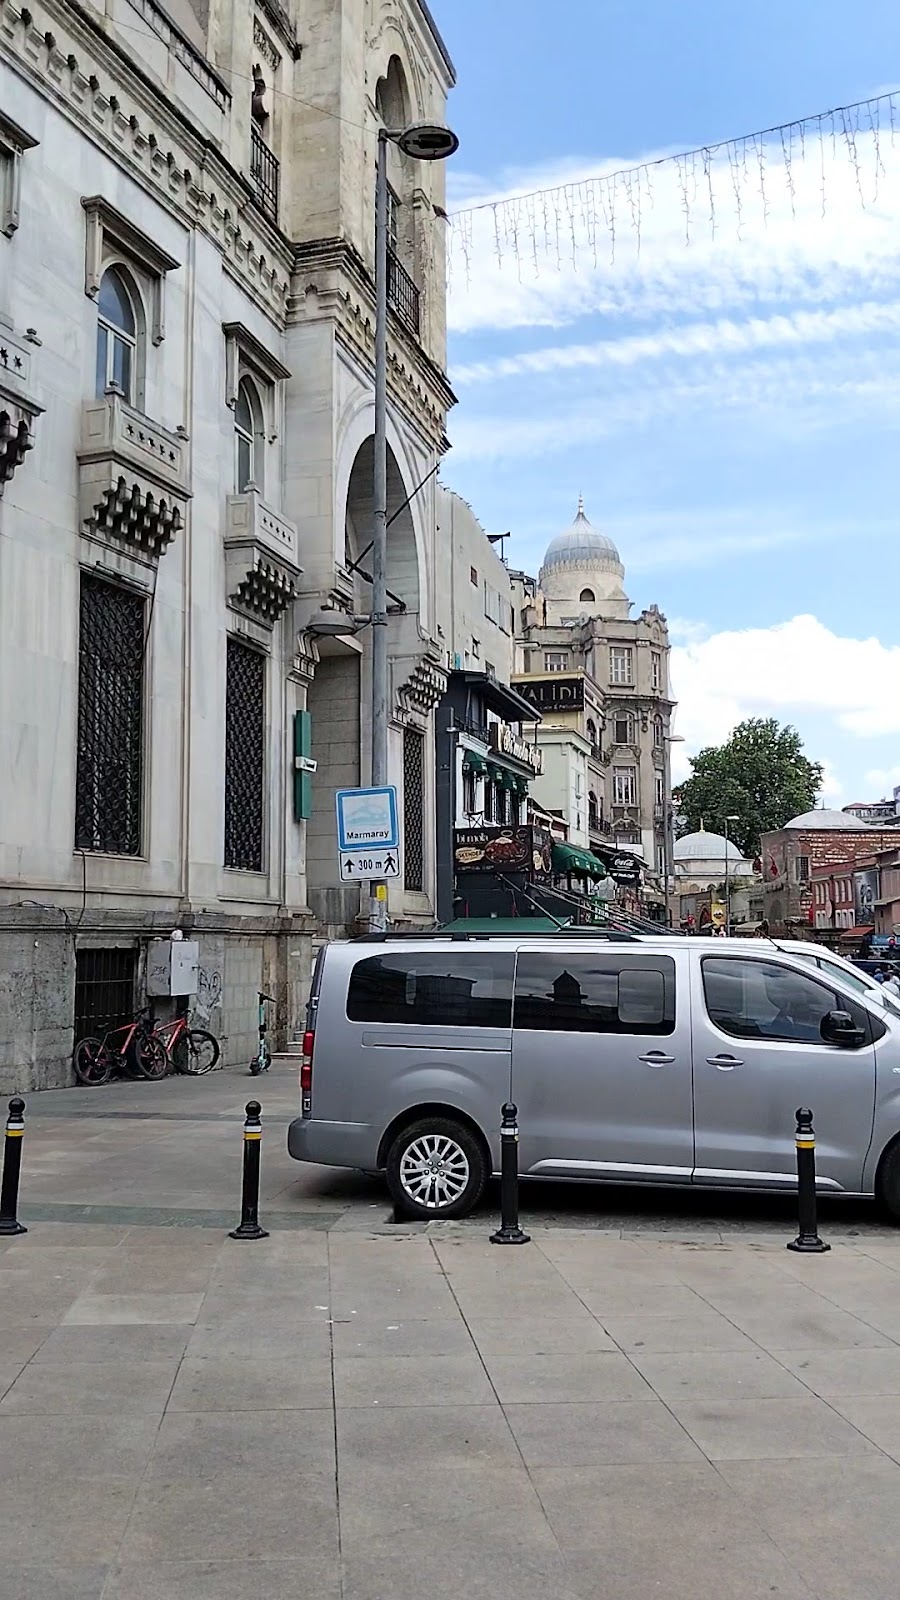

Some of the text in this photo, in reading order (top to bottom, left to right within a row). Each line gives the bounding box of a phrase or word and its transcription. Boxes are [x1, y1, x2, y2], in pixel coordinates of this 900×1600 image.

[346, 831, 389, 839] Marmaray
[358, 859, 382, 870] 300 m
